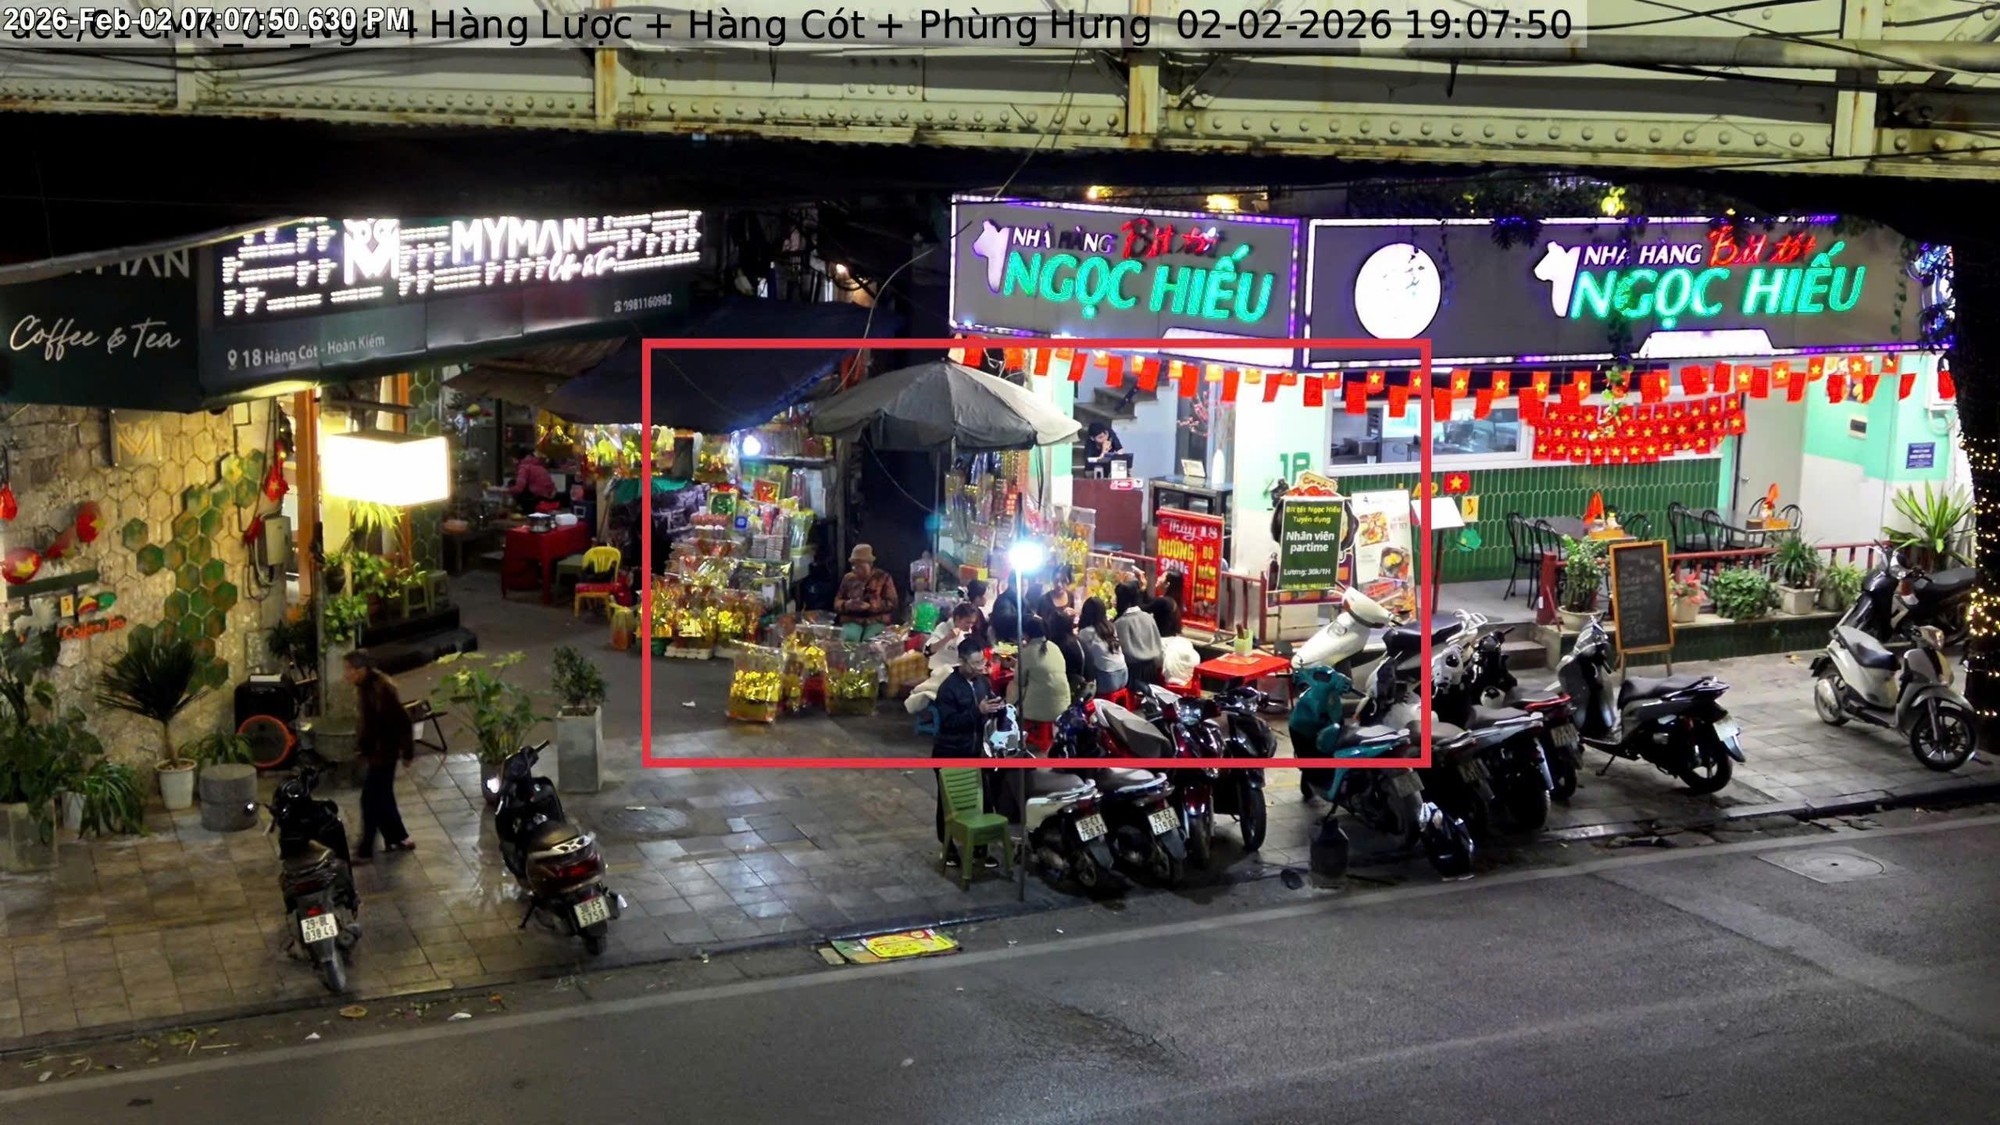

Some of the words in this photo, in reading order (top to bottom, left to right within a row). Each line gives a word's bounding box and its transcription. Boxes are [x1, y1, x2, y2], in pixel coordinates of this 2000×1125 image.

[451, 216, 587, 265] MYMAN
[1638, 239, 1703, 266] HÀNG
[1003, 251, 1143, 320] NGỌC
[1149, 243, 1275, 322] HIẾU
[1569, 267, 1732, 331] NGỌC
[1742, 240, 1867, 316] HIẾU
[10, 314, 100, 361] Coffee
[131, 317, 181, 358] Tea
[242, 348, 262, 368] 18
[265, 349, 297, 366] Hàng
[298, 345, 318, 361] Cót
[327, 338, 357, 356] Hoàn
[358, 333, 386, 353] Kiếm
[1286, 531, 1312, 541] Nhân
[1314, 531, 1334, 541] viên
[1290, 543, 1329, 553] partime
